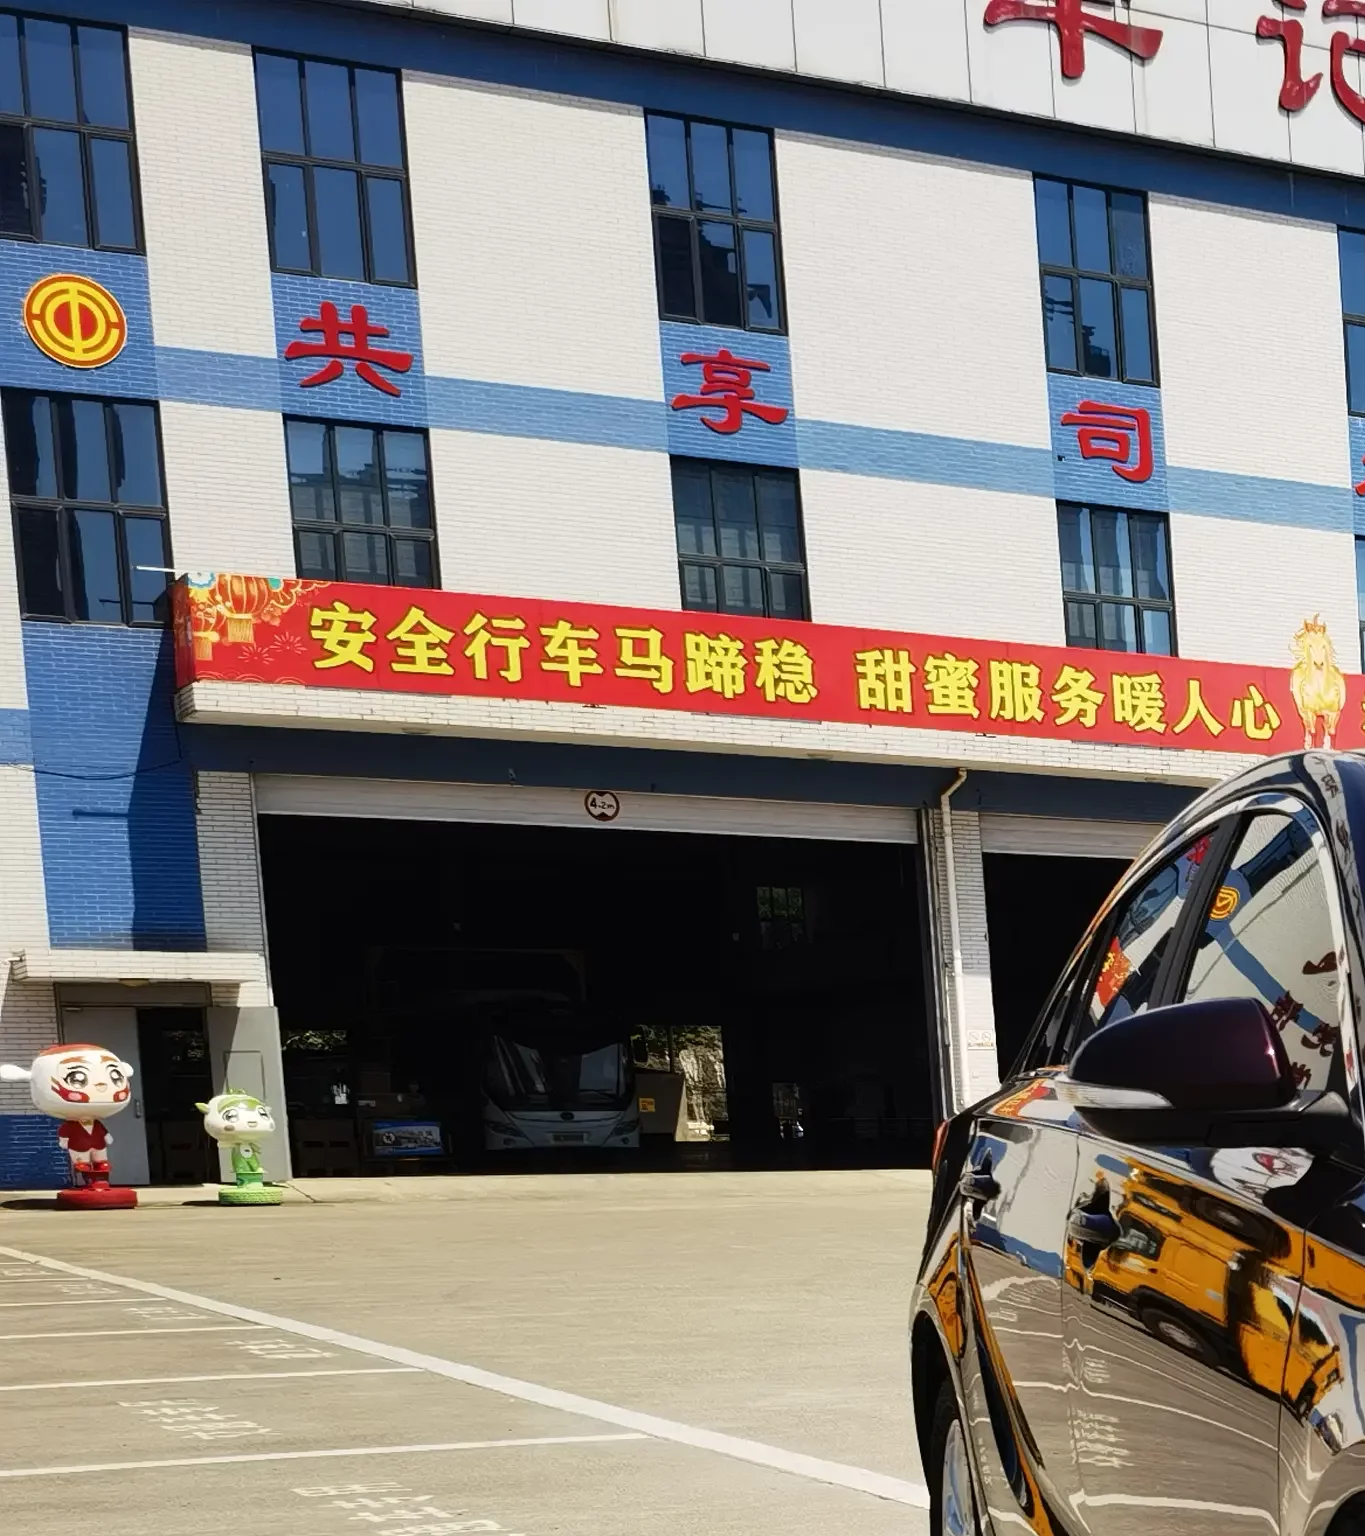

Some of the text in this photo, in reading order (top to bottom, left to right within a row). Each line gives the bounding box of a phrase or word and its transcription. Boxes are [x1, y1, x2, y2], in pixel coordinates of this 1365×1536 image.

[308, 600, 819, 706] 安全行车马蹄稳
[854, 648, 1281, 742] 甜蜜服务暖人心
